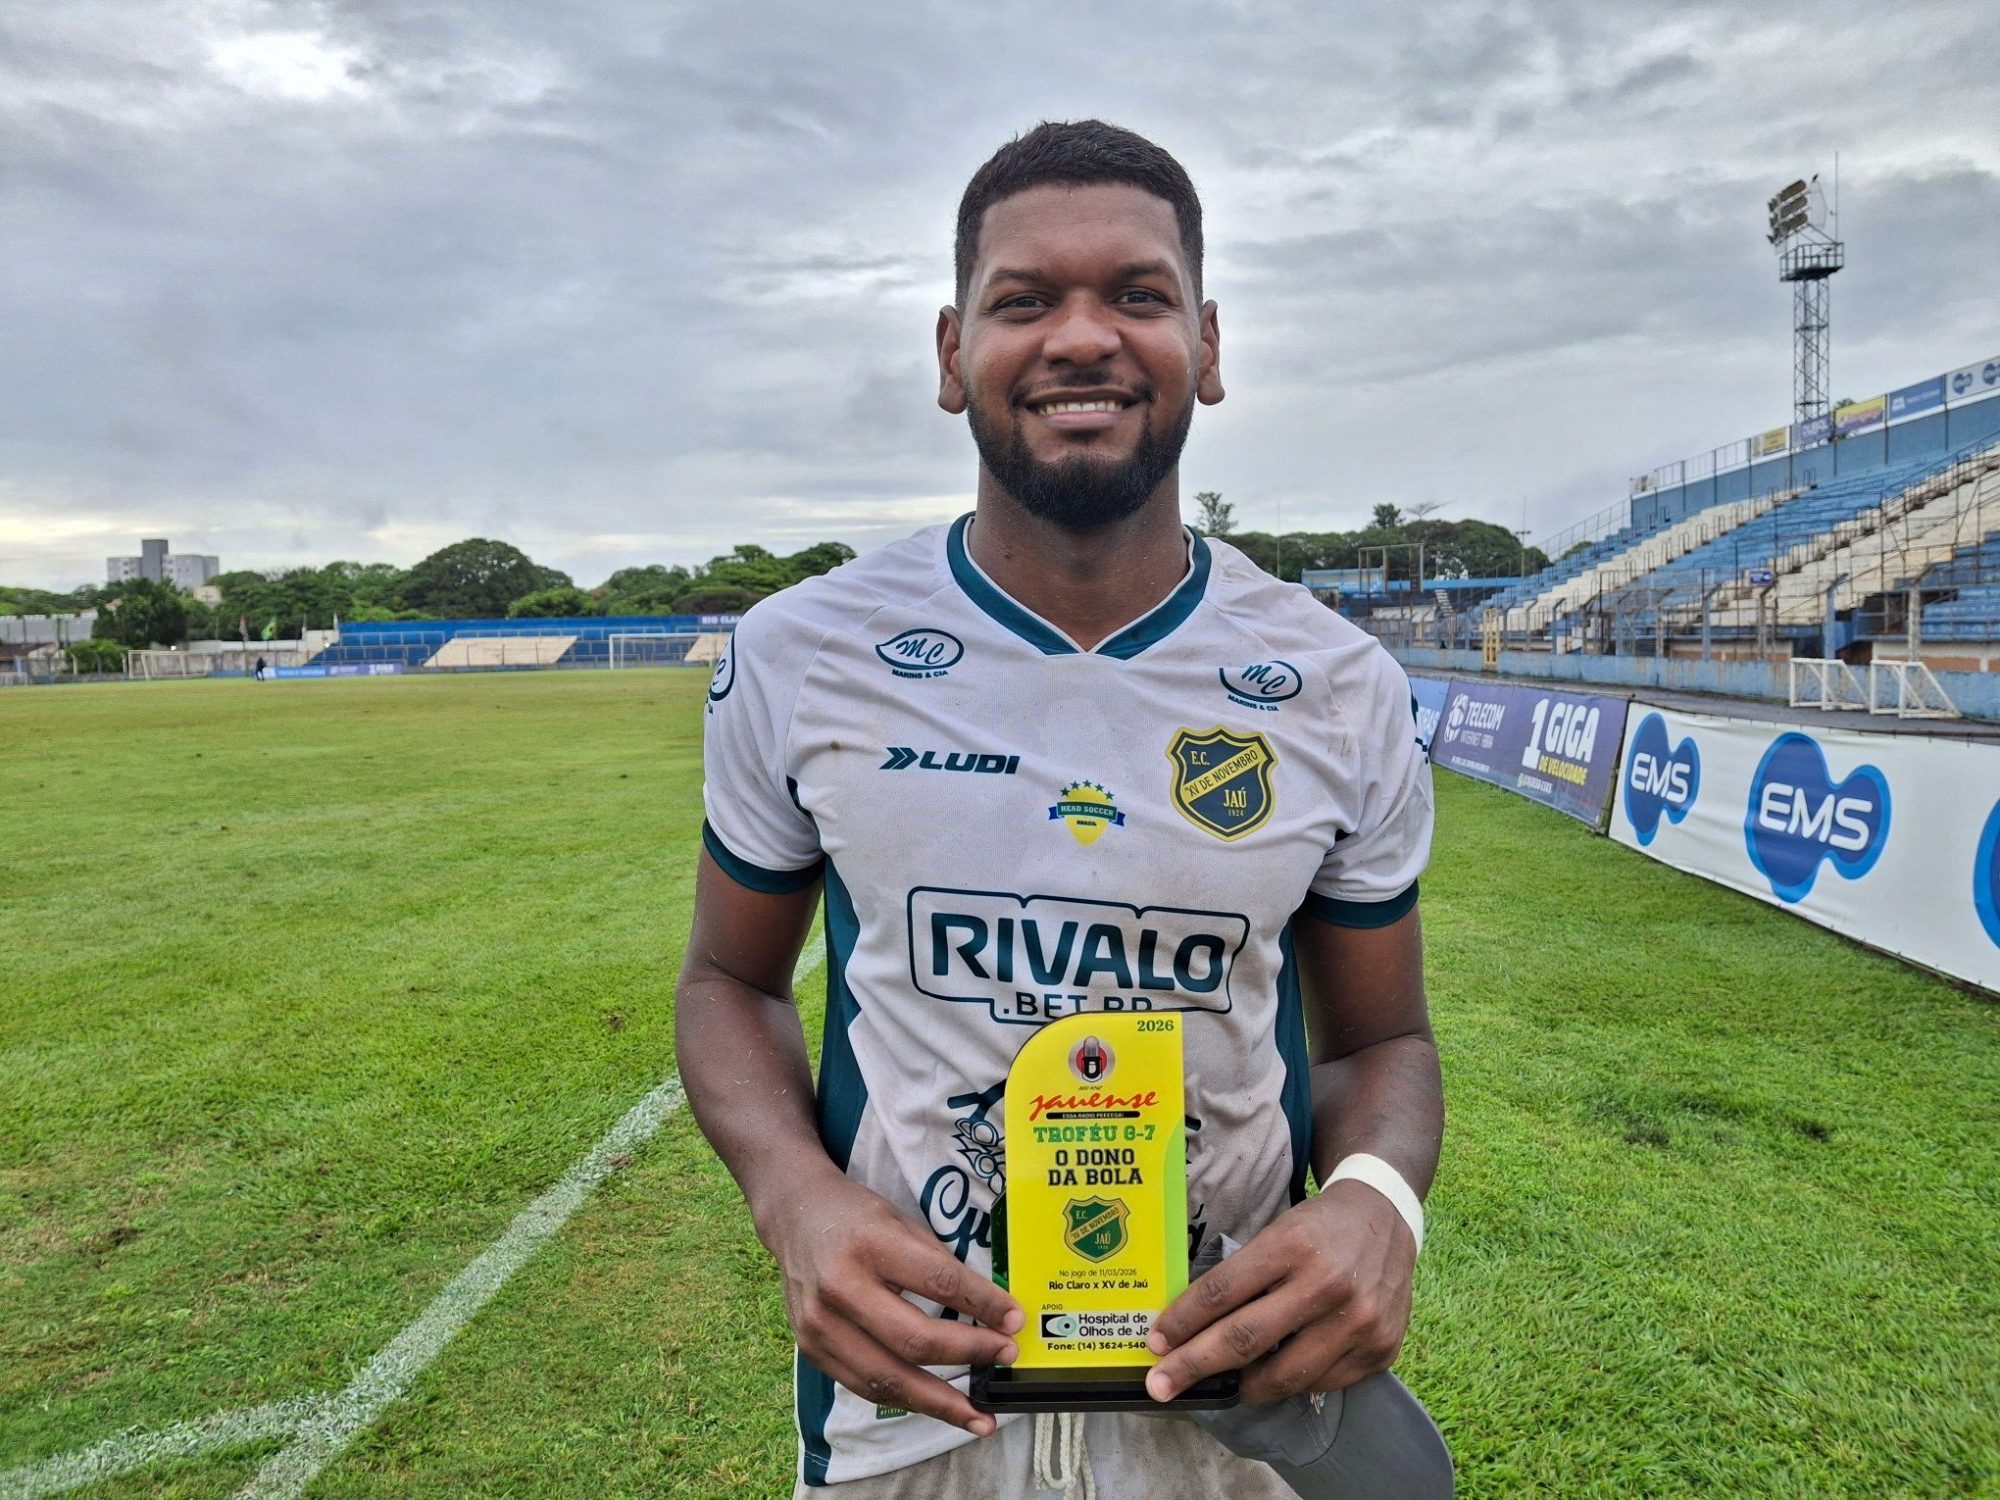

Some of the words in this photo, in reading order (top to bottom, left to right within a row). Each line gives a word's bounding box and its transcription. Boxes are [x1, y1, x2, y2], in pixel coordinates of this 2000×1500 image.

[891, 669, 923, 679] MARINS
[925, 671, 931, 679] &
[933, 670, 949, 678] CIA
[1227, 695, 1258, 709] MARINS
[1465, 701, 1506, 731] TELECOM
[1521, 698, 1550, 770] 1
[1544, 702, 1600, 763] GIGA
[919, 751, 1020, 774] LUDI
[1190, 750, 1210, 766] E.C.
[1199, 776, 1214, 791] DE
[1212, 749, 1258, 783] NOVEMBRO
[1538, 755, 1550, 773] DE
[1547, 757, 1589, 786] VELOCIDADE
[1630, 752, 1691, 804] EMS
[1222, 786, 1247, 808] JAÚ
[1083, 805, 1114, 816] SOCCER
[1227, 809, 1244, 817] 1924
[1759, 782, 1873, 852] EMS
[931, 913, 1226, 993] RIVALO
[1137, 1020, 1174, 1032] 2026
[1029, 1090, 1160, 1121] jauense
[1033, 1123, 1118, 1142] TROFÉU
[1056, 1149, 1069, 1166] O
[1076, 1149, 1135, 1166] DONO
[1048, 1169, 1078, 1186] DA
[1086, 1168, 1143, 1185] BOLA
[1088, 1206, 1120, 1230] NOVEMBRO
[1094, 1231, 1111, 1245] JAÚ
[1071, 1269, 1086, 1278] jogo
[1088, 1268, 1097, 1276] de
[1099, 1268, 1137, 1277] 11/03/2026
[1049, 1281, 1063, 1290] Rio
[1066, 1280, 1090, 1289] Claro
[1102, 1280, 1115, 1289] XV
[1118, 1280, 1130, 1288] de
[1132, 1278, 1148, 1288] Jaú
[1078, 1313, 1130, 1326] Hospital
[1132, 1312, 1148, 1324] de
[1079, 1326, 1114, 1337] Olhos
[1117, 1325, 1132, 1336] de
[1135, 1325, 1150, 1336] Ja
[1077, 1341, 1096, 1351] (14)
[1099, 1341, 1147, 1350] 3624-540
